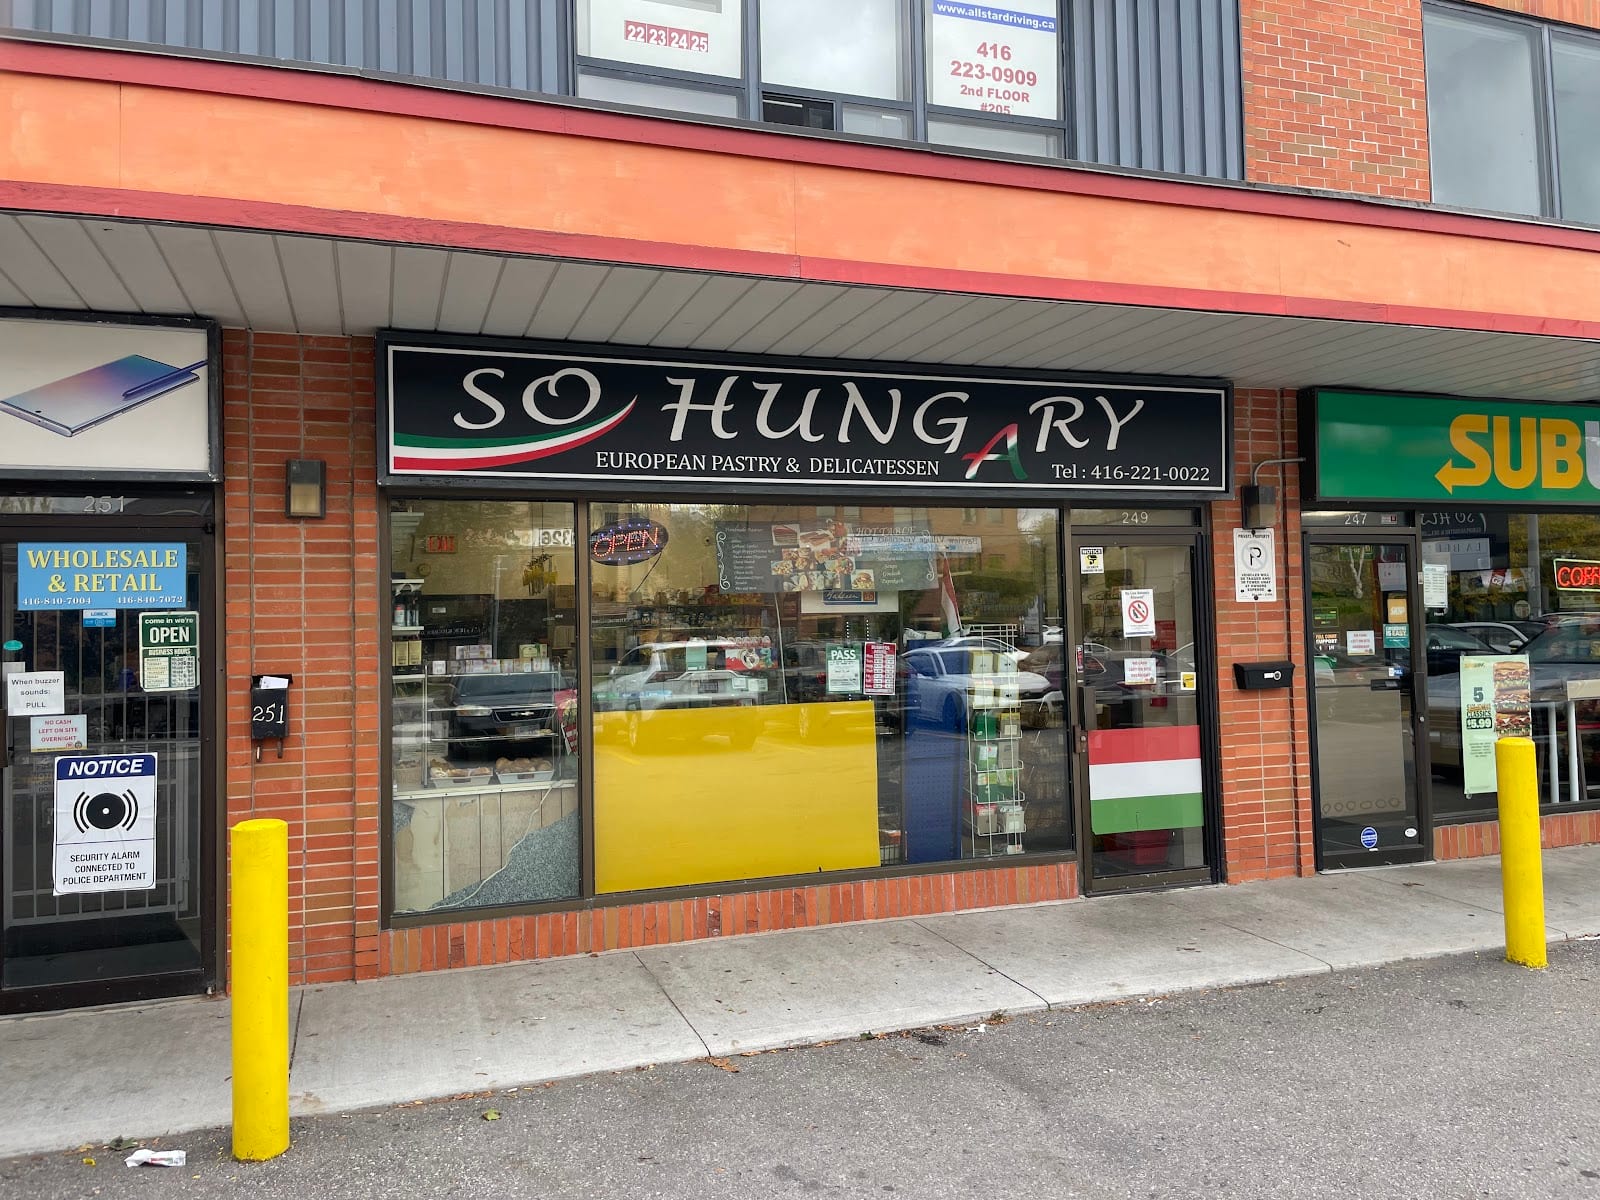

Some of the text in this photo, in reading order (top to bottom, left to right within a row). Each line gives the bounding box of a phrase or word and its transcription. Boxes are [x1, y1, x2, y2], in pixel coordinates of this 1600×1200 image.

[937, 3, 1055, 29] www.allstardriving.ca
[976, 42, 1011, 61] 416
[950, 60, 1037, 87] 223-0909
[960, 84, 1030, 102] 2nd FLOOR
[980, 102, 1010, 114] #205
[453, 367, 1145, 480] SO HUNGARY
[1434, 413, 1600, 495] SUB
[595, 452, 940, 476] EUROPEAN PASTRY & DELICATESSEN
[1091, 465, 1210, 481] 416-221-0022
[83, 495, 125, 513] 251
[1122, 512, 1149, 524] 249
[1344, 513, 1368, 526] 247
[427, 536, 455, 553] EXIT
[593, 526, 659, 557] OPEN
[27, 550, 179, 570] WHOLESALE
[47, 573, 163, 593] & RETAIL
[1557, 566, 1600, 587] COFF
[149, 626, 190, 644] OPEN
[830, 649, 857, 661] PASS
[20, 688, 50, 696] sounds:
[1473, 687, 1484, 702] 5
[252, 703, 285, 725] 251
[1467, 718, 1492, 728] $5.99
[68, 758, 145, 777] NOTICE
[70, 851, 140, 863] SECURITY ALARM
[75, 862, 136, 873] CONNECTED TO
[63, 872, 147, 885] POLICE DEPARTMENT
